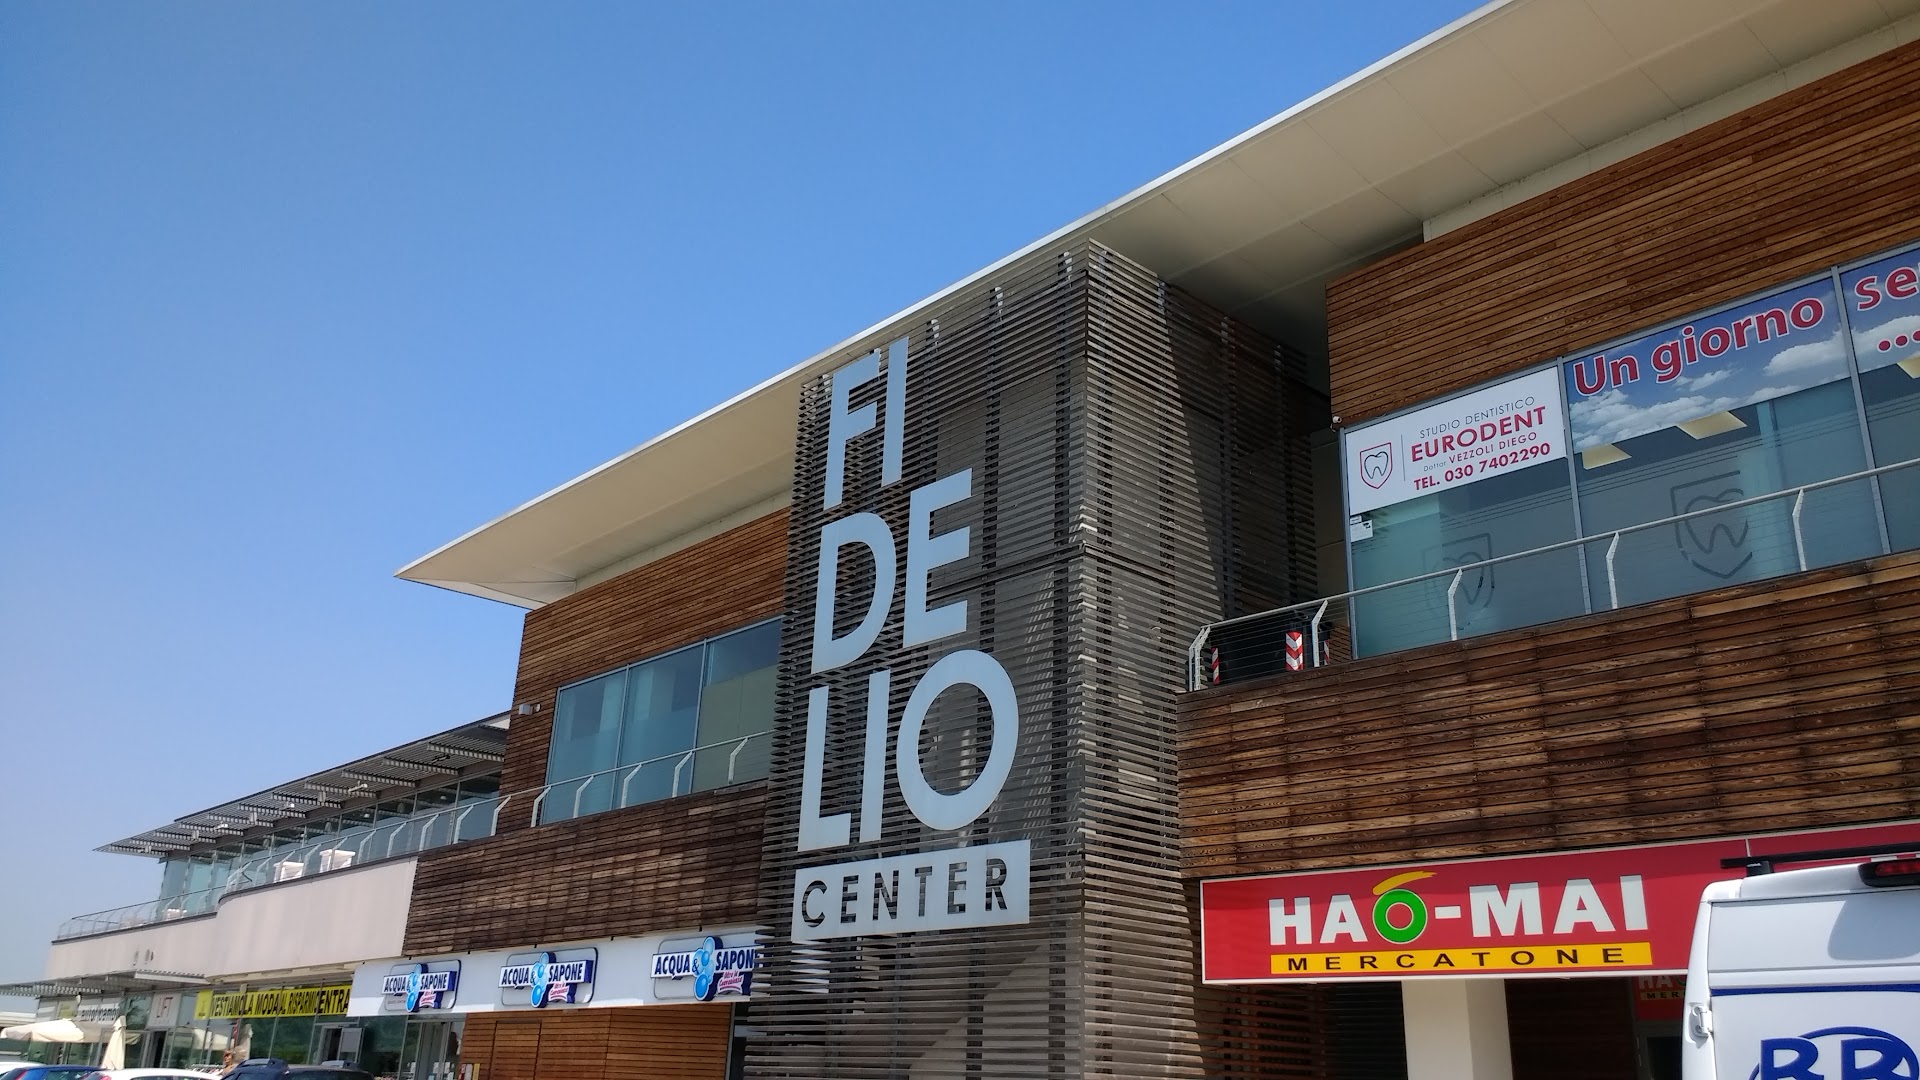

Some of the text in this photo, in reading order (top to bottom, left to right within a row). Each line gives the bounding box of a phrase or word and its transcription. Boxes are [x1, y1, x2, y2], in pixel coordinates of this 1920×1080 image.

[1572, 262, 1920, 397] Un giorno se
[1411, 405, 1546, 463] EURODENT
[1420, 396, 1535, 439] STUDIO DENTISTICO
[1413, 442, 1551, 491] TEL. 030 7402290
[1423, 431, 1537, 472] Dottor VEZZOLI DIEGO
[801, 857, 1008, 928] CENTER
[501, 967, 530, 986] ACQUA
[548, 962, 584, 982] SAPONE
[654, 954, 691, 976] ACQUA
[1287, 947, 1624, 971] MERCATONE
[255, 991, 278, 1015] MODA
[384, 976, 407, 993] ACQUA
[420, 973, 448, 991] SAPONE
